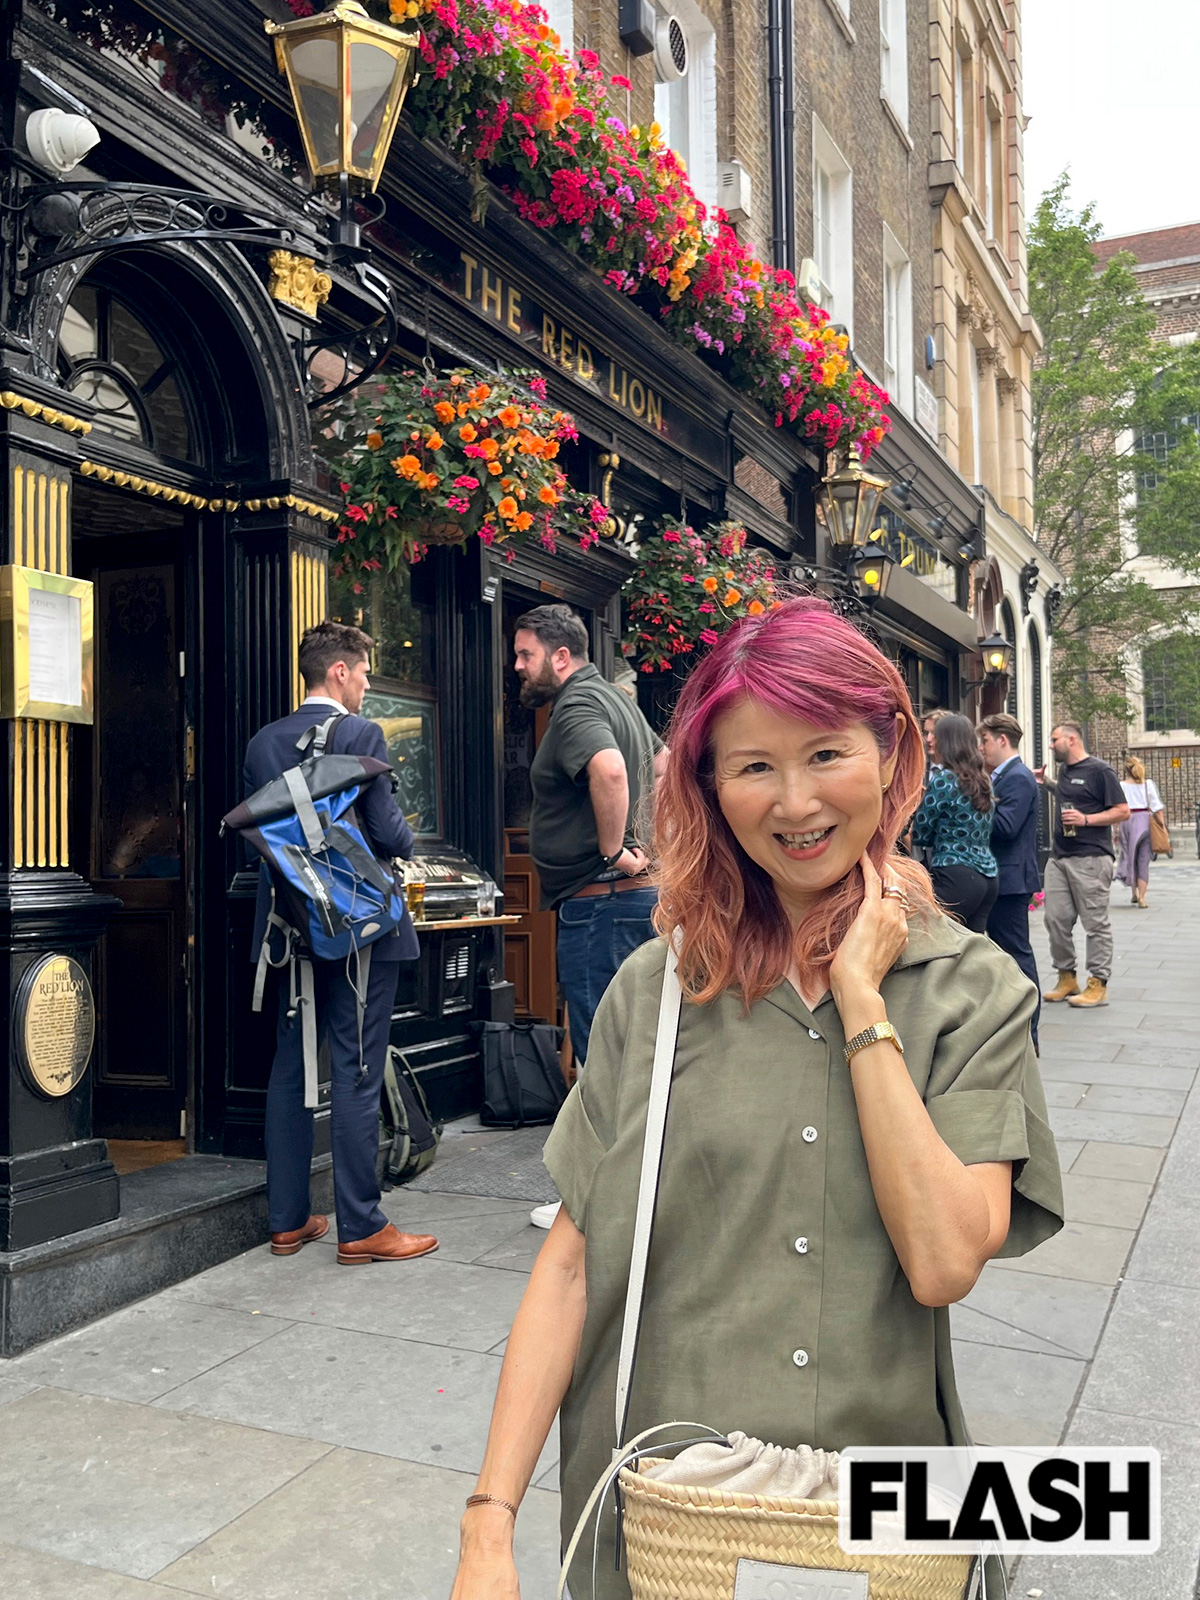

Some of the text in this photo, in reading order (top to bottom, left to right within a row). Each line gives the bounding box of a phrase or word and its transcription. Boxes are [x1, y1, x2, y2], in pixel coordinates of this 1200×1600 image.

[460, 251, 663, 431] THE RED LION
[54, 972, 70, 981] THE
[39, 980, 84, 996] RED LION
